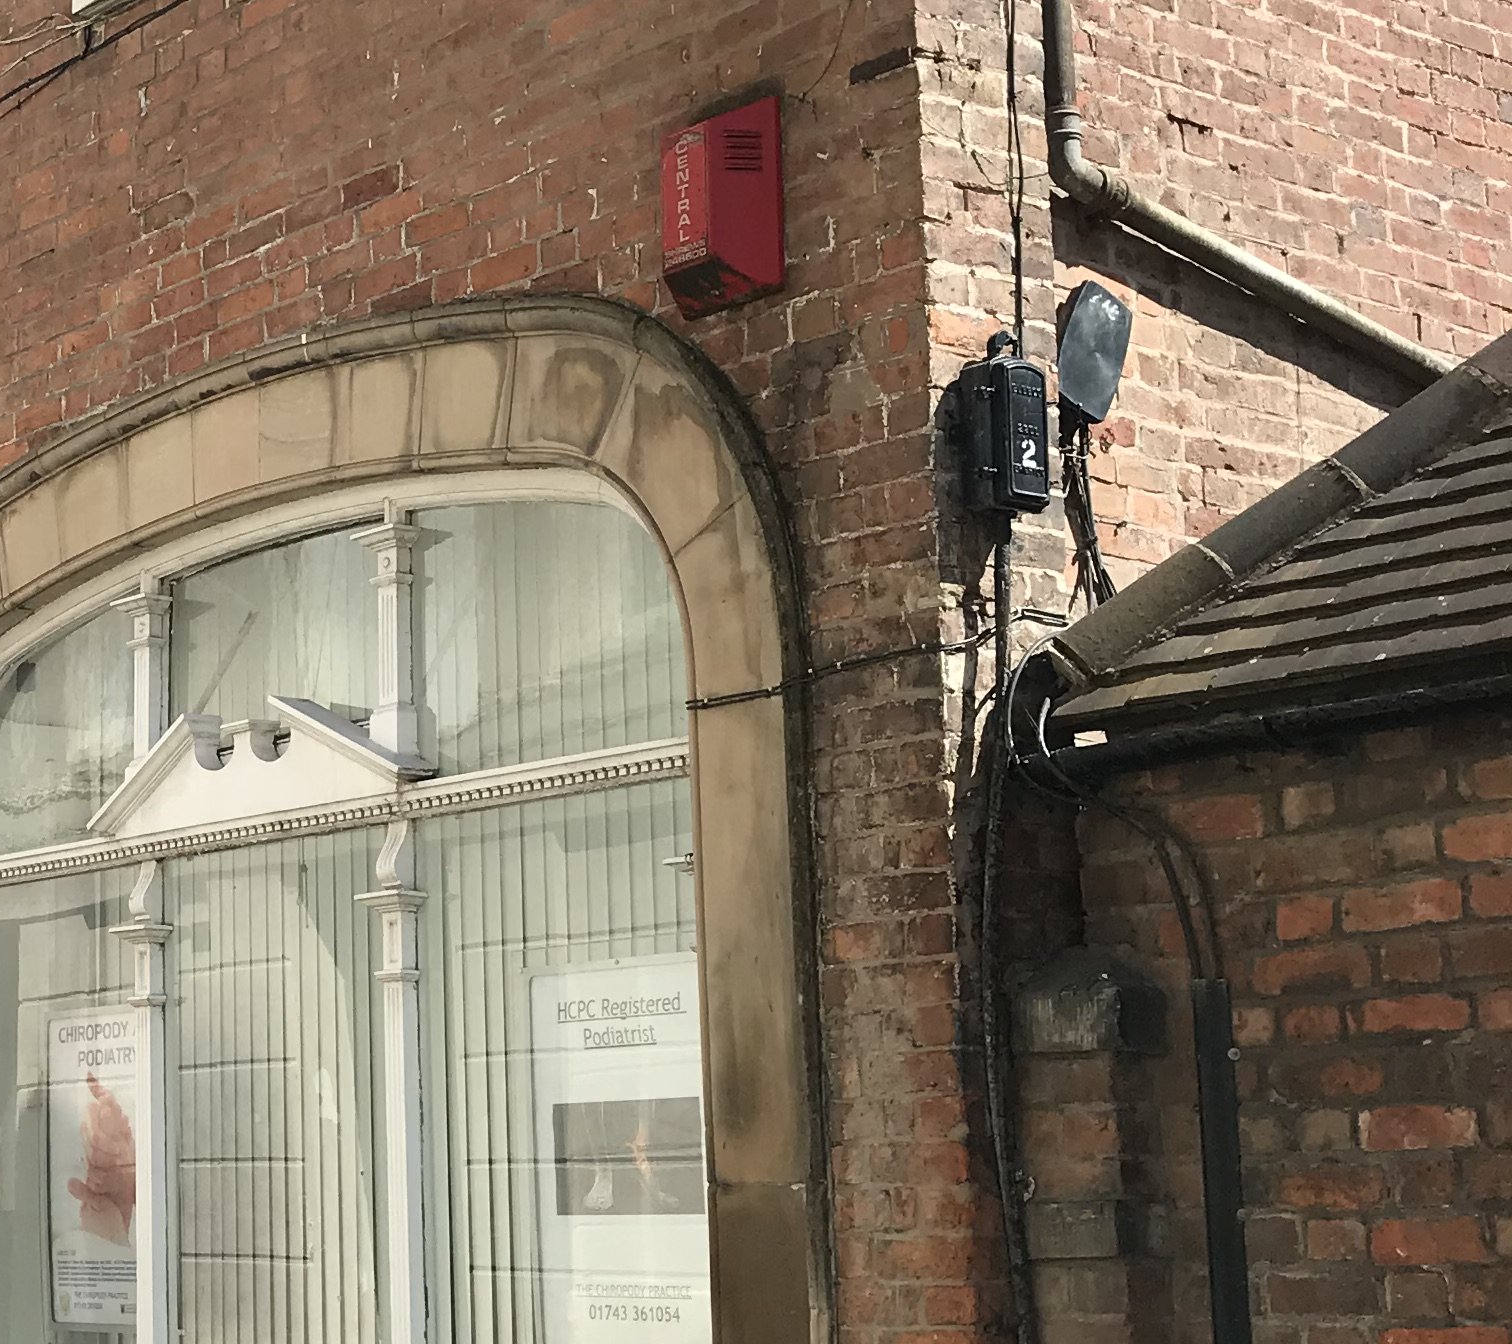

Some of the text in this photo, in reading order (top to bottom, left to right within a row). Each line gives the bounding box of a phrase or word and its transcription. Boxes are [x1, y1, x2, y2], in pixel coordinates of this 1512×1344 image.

[675, 140, 691, 243] CENTRAL
[557, 991, 682, 1021] HCPC Registered
[58, 1021, 128, 1044] CHIROPODY
[583, 1024, 656, 1047] Podiatrist
[576, 1283, 692, 1299] THE CHIROPODY PRACTICE
[589, 1304, 680, 1323] 01743 361054
